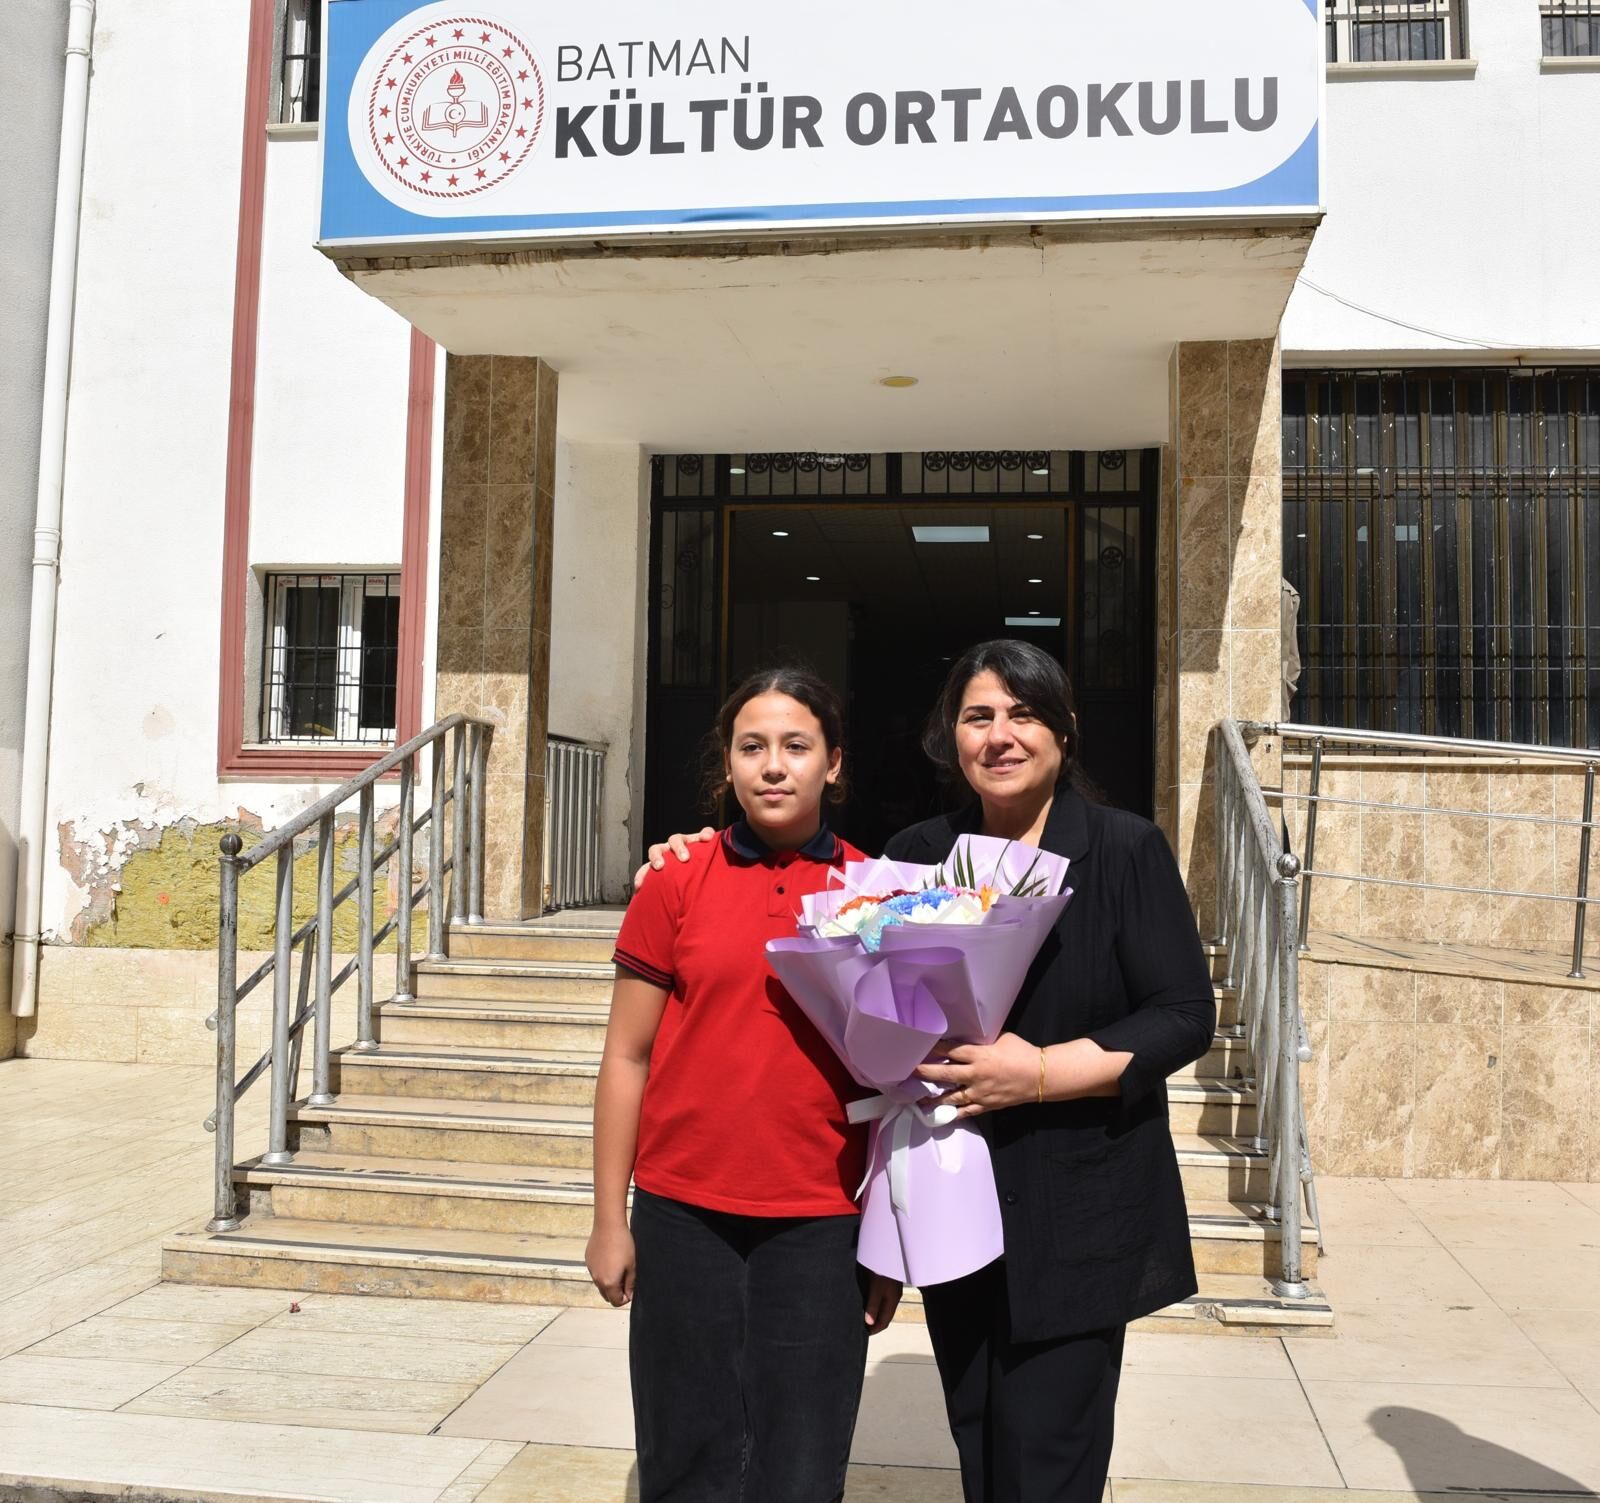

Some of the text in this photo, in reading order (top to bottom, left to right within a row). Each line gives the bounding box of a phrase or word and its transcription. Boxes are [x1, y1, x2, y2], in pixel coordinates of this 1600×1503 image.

[485, 61, 512, 99] EĞİTİM
[557, 35, 751, 82] BATMAN
[401, 51, 450, 122] CUMHURİYETİ
[404, 125, 441, 162] TÜRKİYE
[467, 103, 512, 161] BAKANLIĞI
[554, 76, 1278, 159] KÜLTÜR ORTAOKULU
